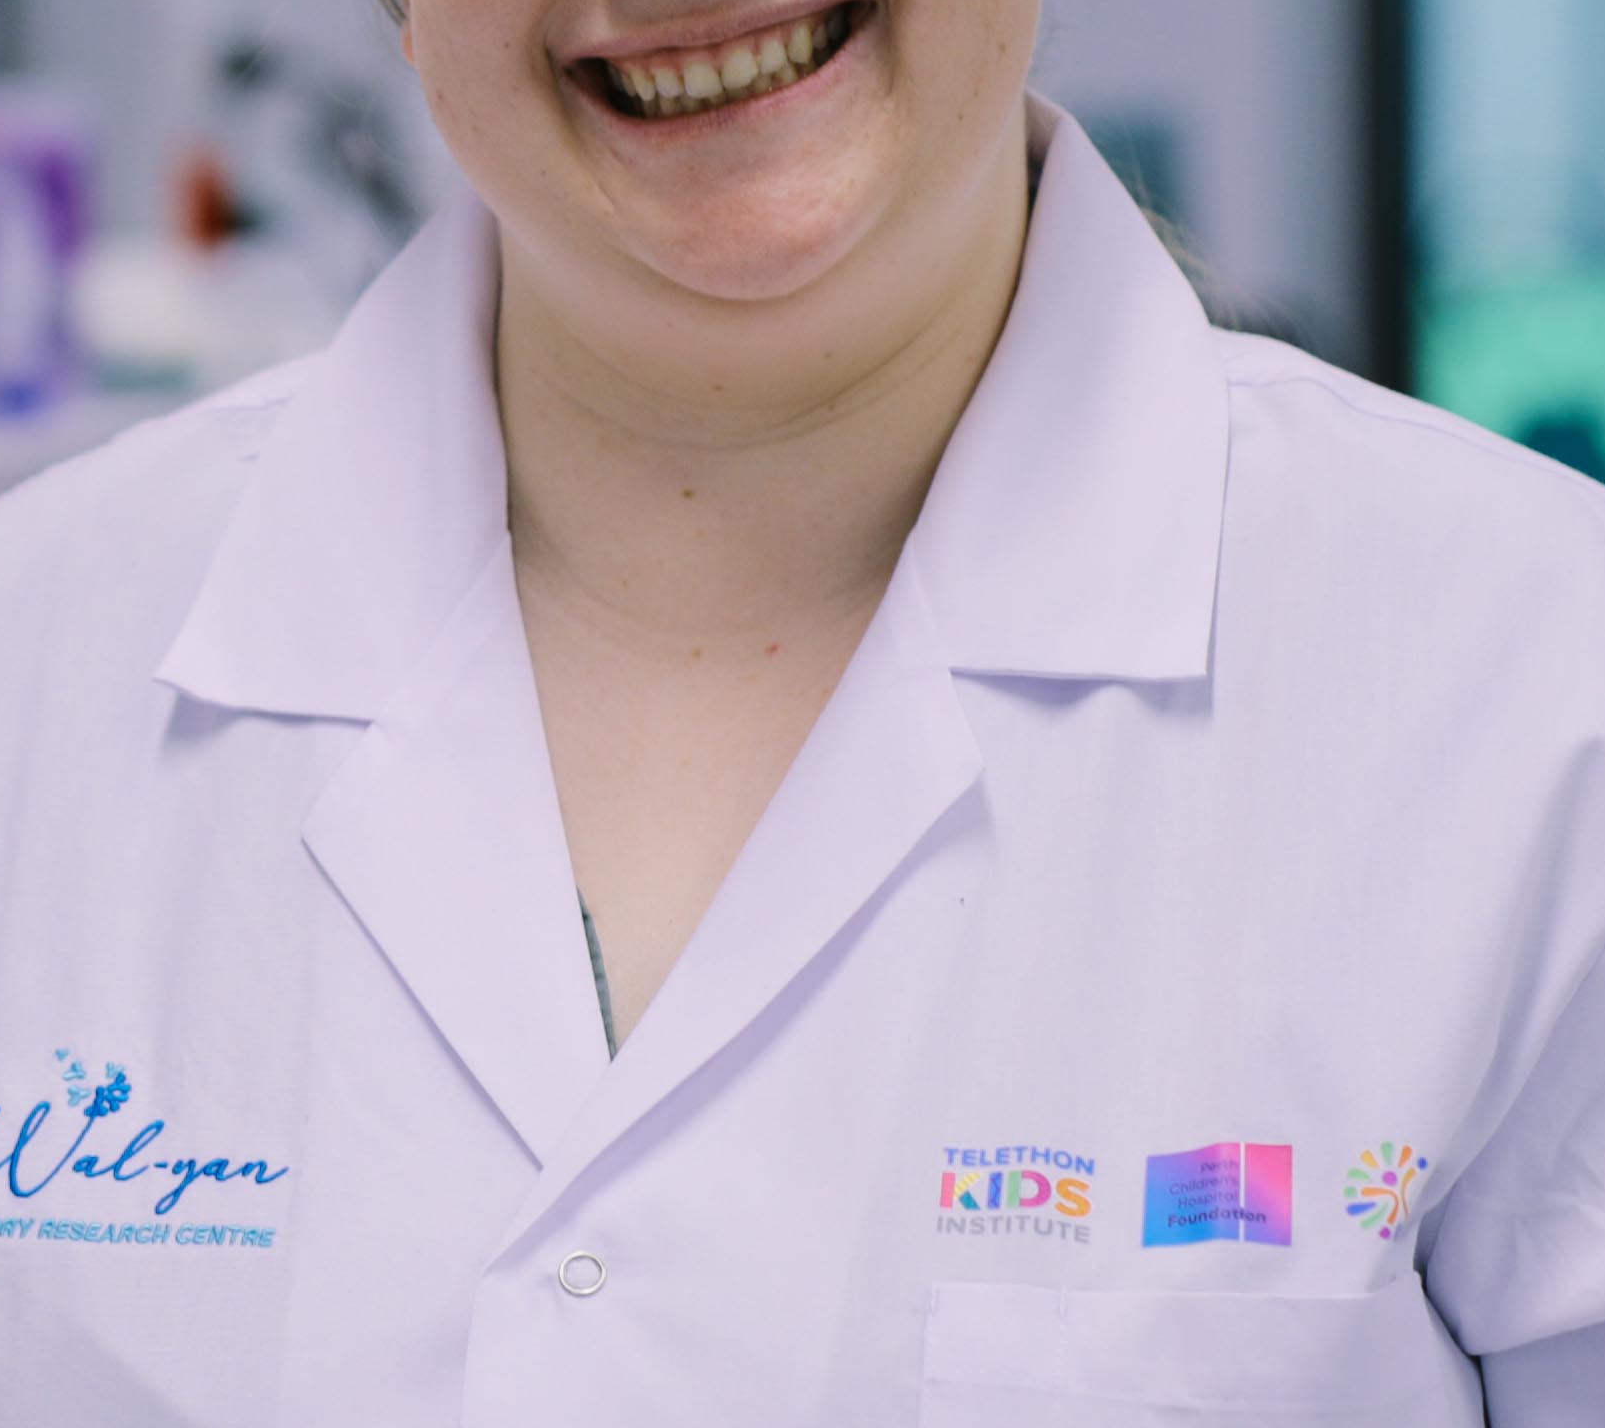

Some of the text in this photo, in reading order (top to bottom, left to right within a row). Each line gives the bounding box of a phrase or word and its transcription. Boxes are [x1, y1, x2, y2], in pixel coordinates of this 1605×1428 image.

[943, 1145, 1095, 1176] TELETHON
[1200, 1159, 1239, 1173] Perth
[940, 1169, 1092, 1218] KIDS
[1169, 1175, 1240, 1195] Children's
[1178, 1190, 1240, 1209] Hospital
[936, 1215, 1091, 1244] INSTITUTE
[1168, 1207, 1268, 1228] Foundation
[37, 1219, 170, 1245] RESEARCH
[174, 1225, 276, 1248] CENTRE
